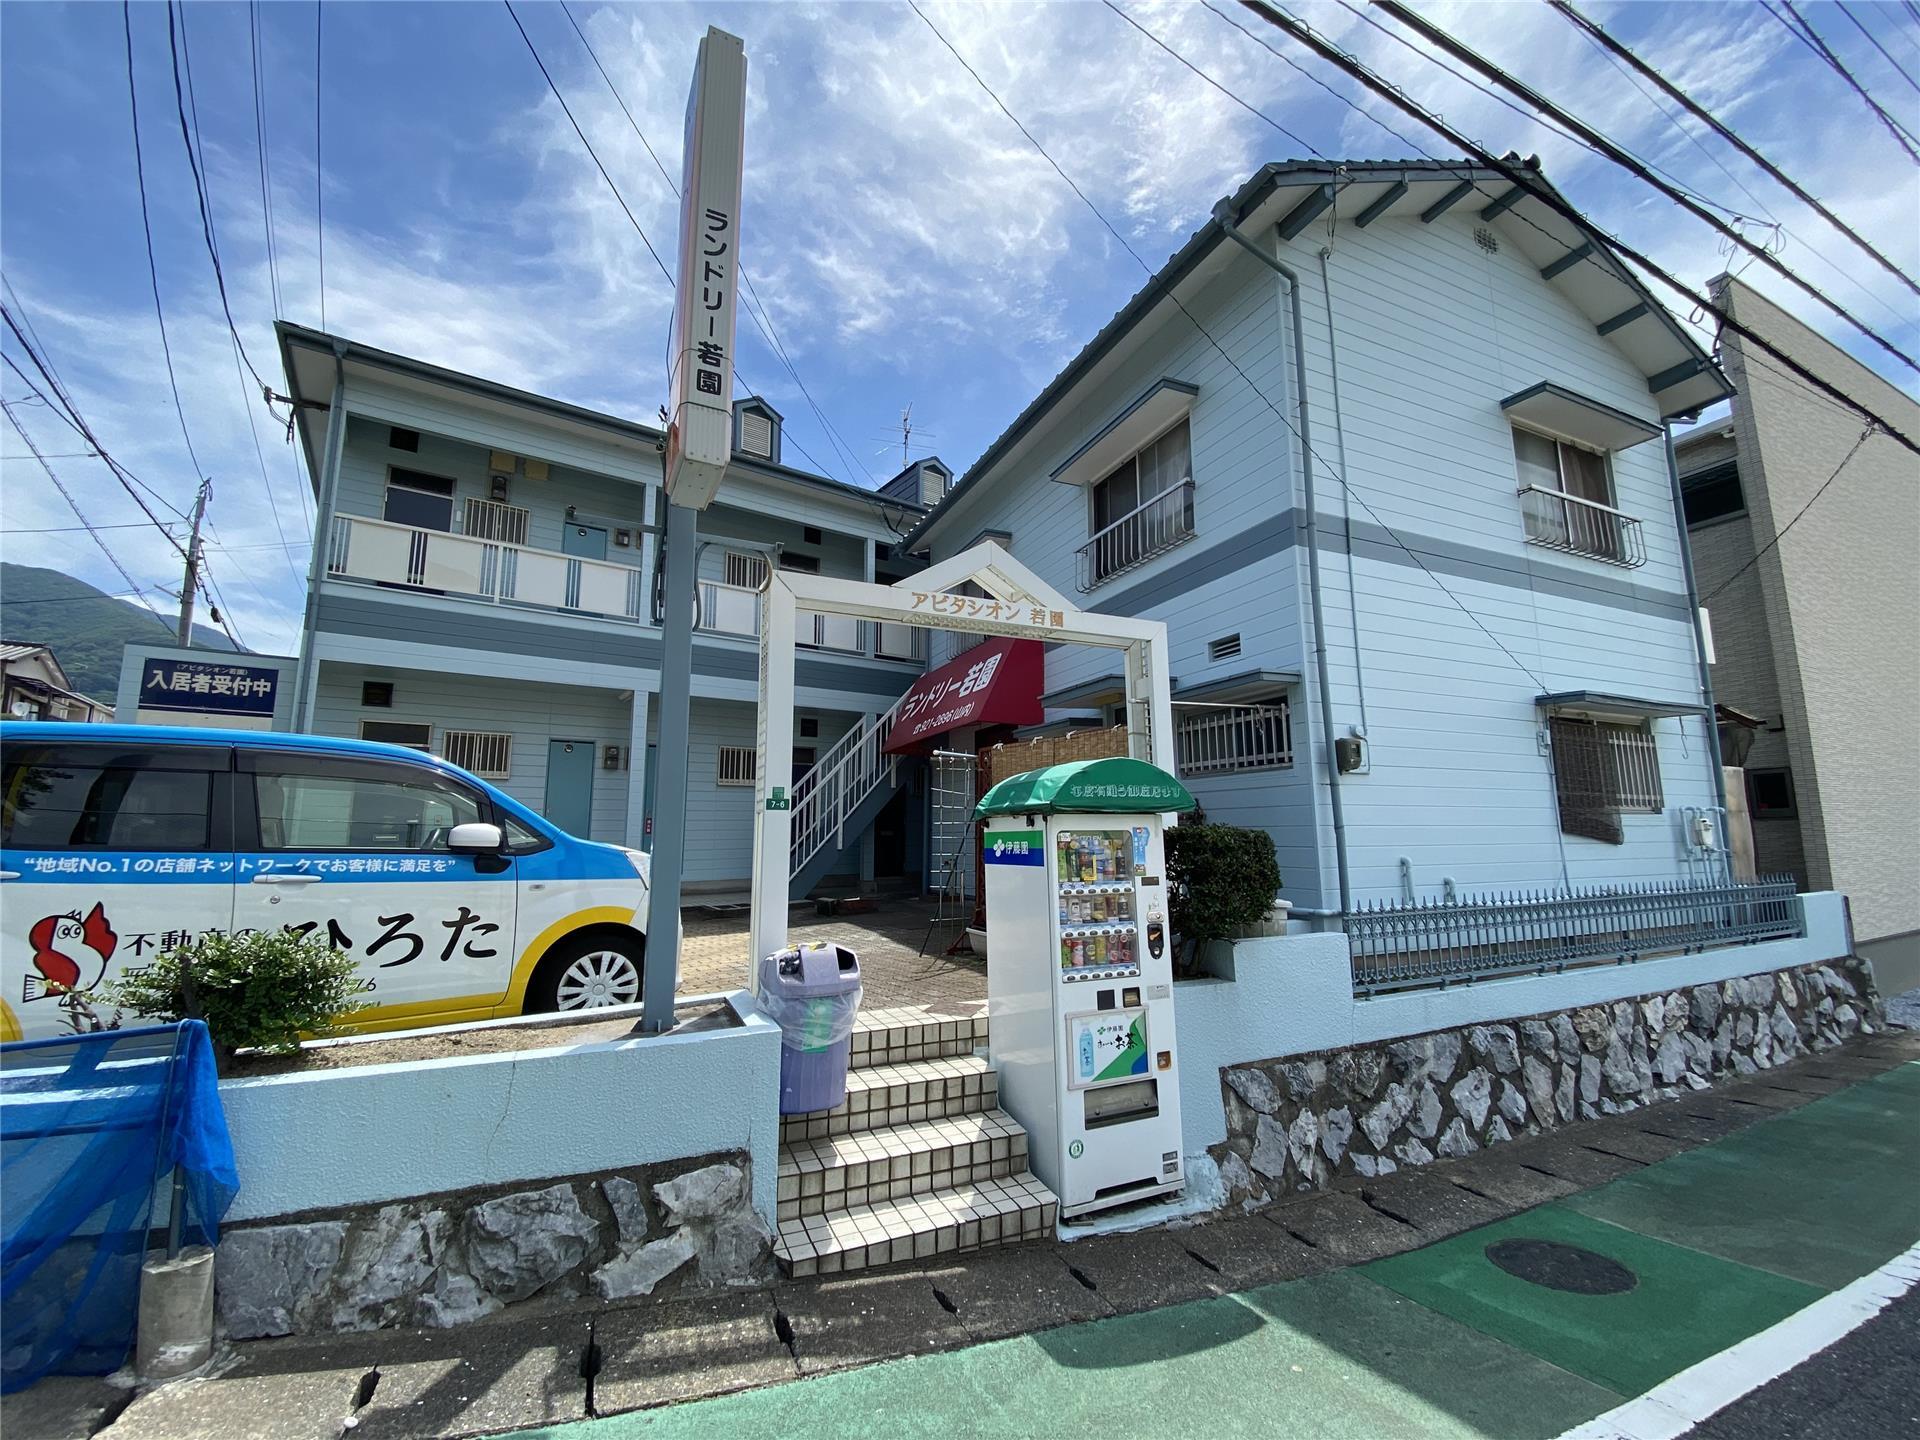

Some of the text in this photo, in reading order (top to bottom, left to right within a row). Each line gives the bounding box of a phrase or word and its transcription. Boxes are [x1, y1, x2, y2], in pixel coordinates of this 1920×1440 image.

[696, 207, 728, 396] ランドリー若園
[911, 591, 1020, 621] アビタシオン
[146, 669, 272, 698] 入居者受付中
[901, 653, 1002, 722] ランドリー若園
[771, 800, 785, 808] 7-6
